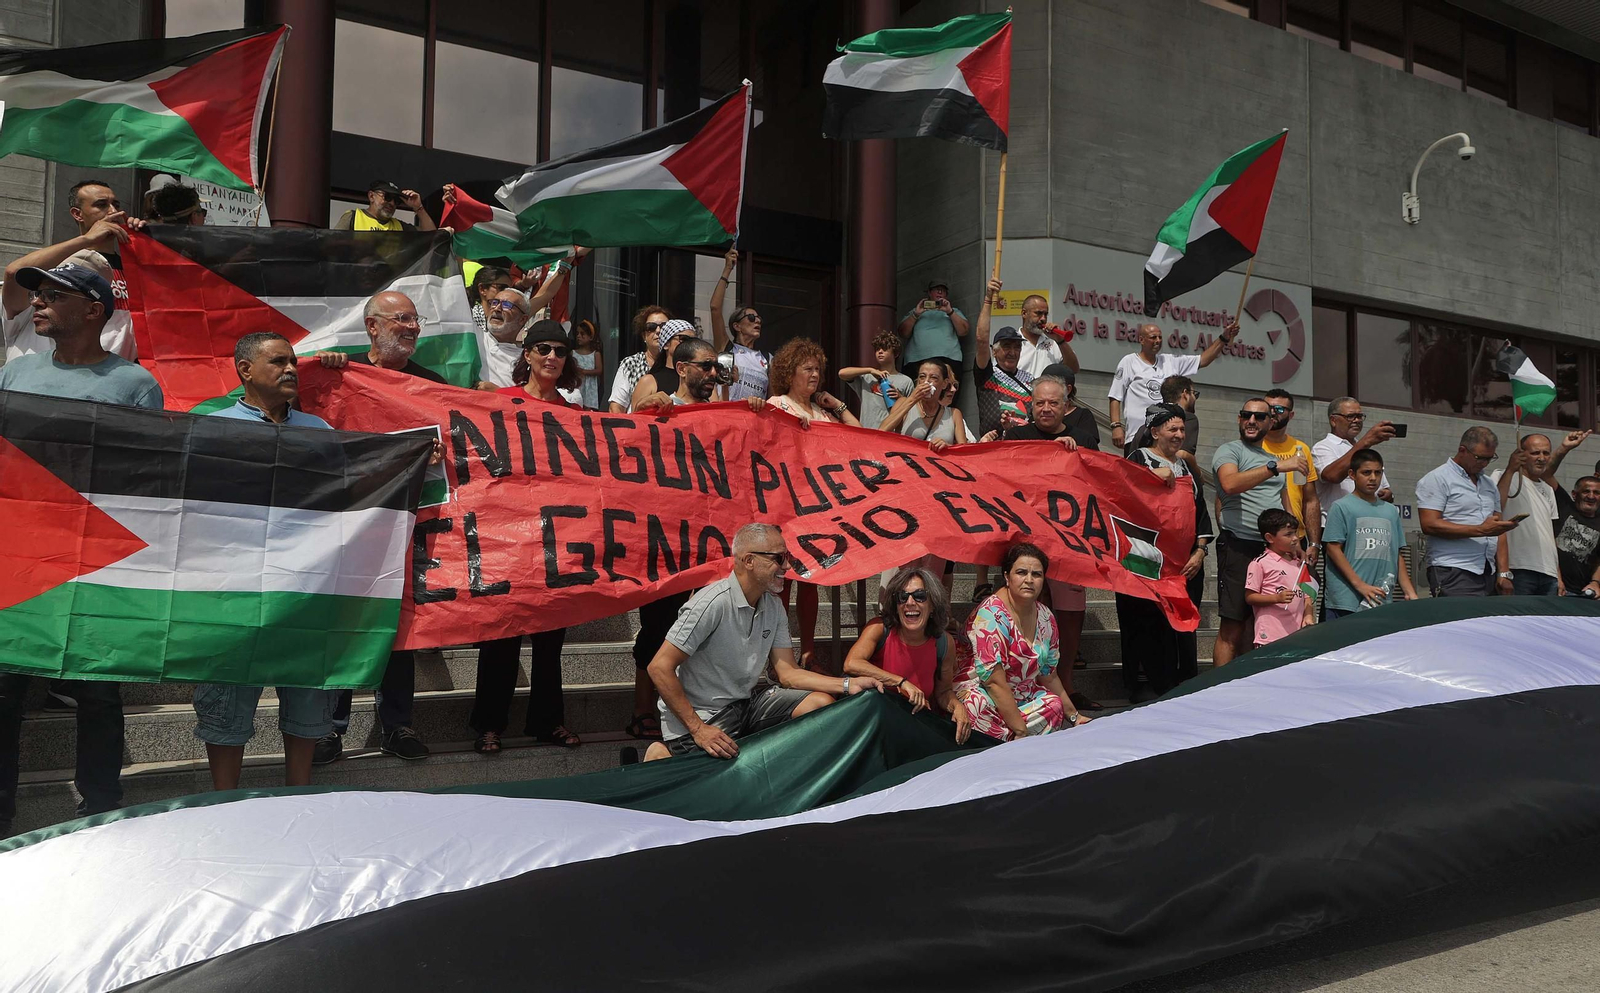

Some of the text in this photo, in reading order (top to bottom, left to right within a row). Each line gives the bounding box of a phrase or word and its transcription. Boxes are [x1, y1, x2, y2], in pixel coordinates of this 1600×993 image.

[1063, 283, 1236, 328] Autorida Portuaria
[1063, 314, 1086, 335] de
[1093, 317, 1109, 338] la
[1168, 329, 1189, 349] de
[1194, 333, 1265, 360] Aleciras
[750, 449, 976, 517] PUERTO
[413, 512, 511, 605] EL
[933, 490, 1032, 535] EN
